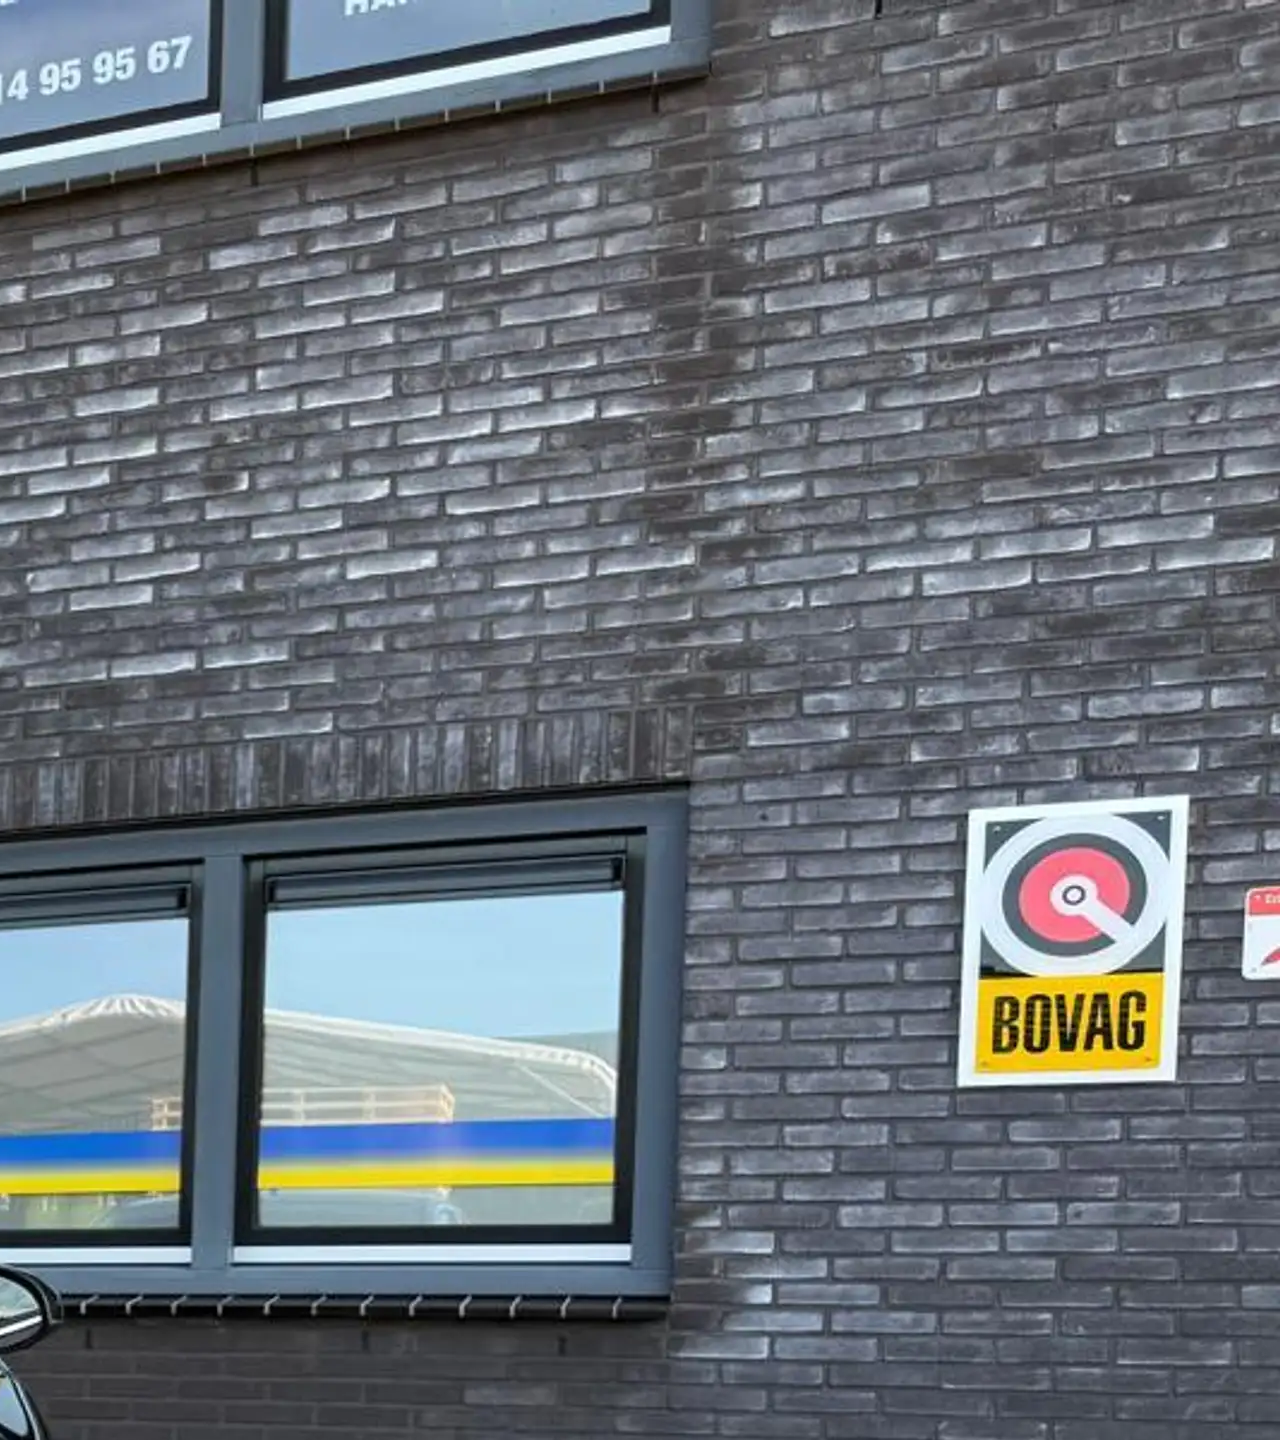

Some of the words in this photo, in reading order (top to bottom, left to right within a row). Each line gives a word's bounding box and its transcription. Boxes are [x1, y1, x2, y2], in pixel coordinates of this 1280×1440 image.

[40, 58, 82, 95] 95
[93, 47, 136, 85] 95
[148, 35, 192, 73] 67
[992, 990, 1147, 1055] BOVAG
